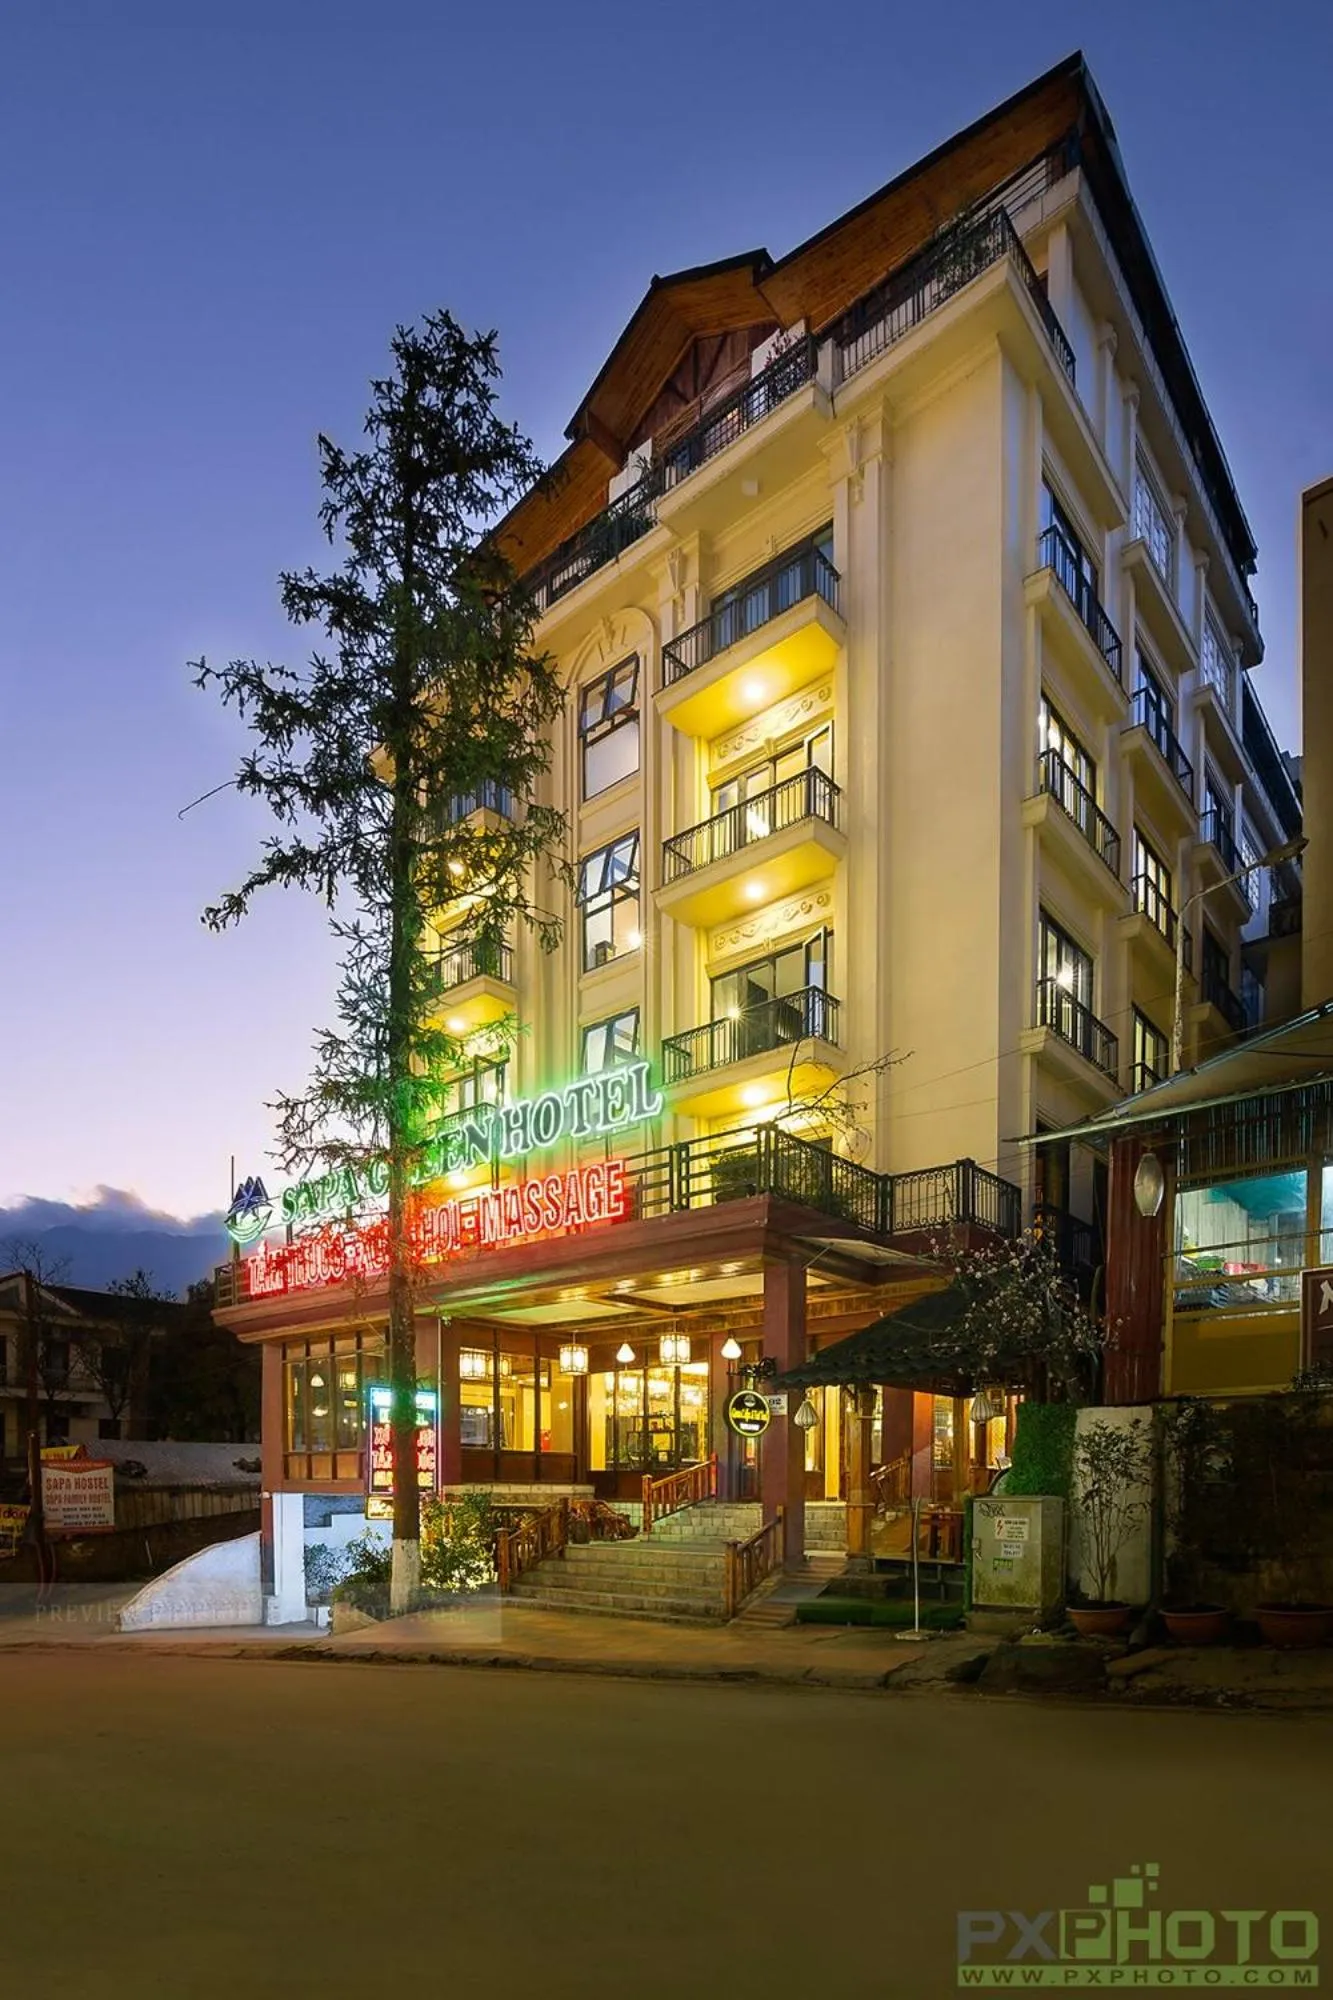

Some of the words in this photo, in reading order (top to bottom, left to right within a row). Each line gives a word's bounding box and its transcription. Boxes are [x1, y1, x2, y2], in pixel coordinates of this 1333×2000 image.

[281, 1166, 360, 1224] SAPA
[365, 1115, 495, 1198] GEEN
[500, 1062, 664, 1158] HOTEL
[480, 1159, 625, 1243] MASSAGE
[46, 1478, 72, 1491] SAPA
[74, 1477, 109, 1490] HOSTEL
